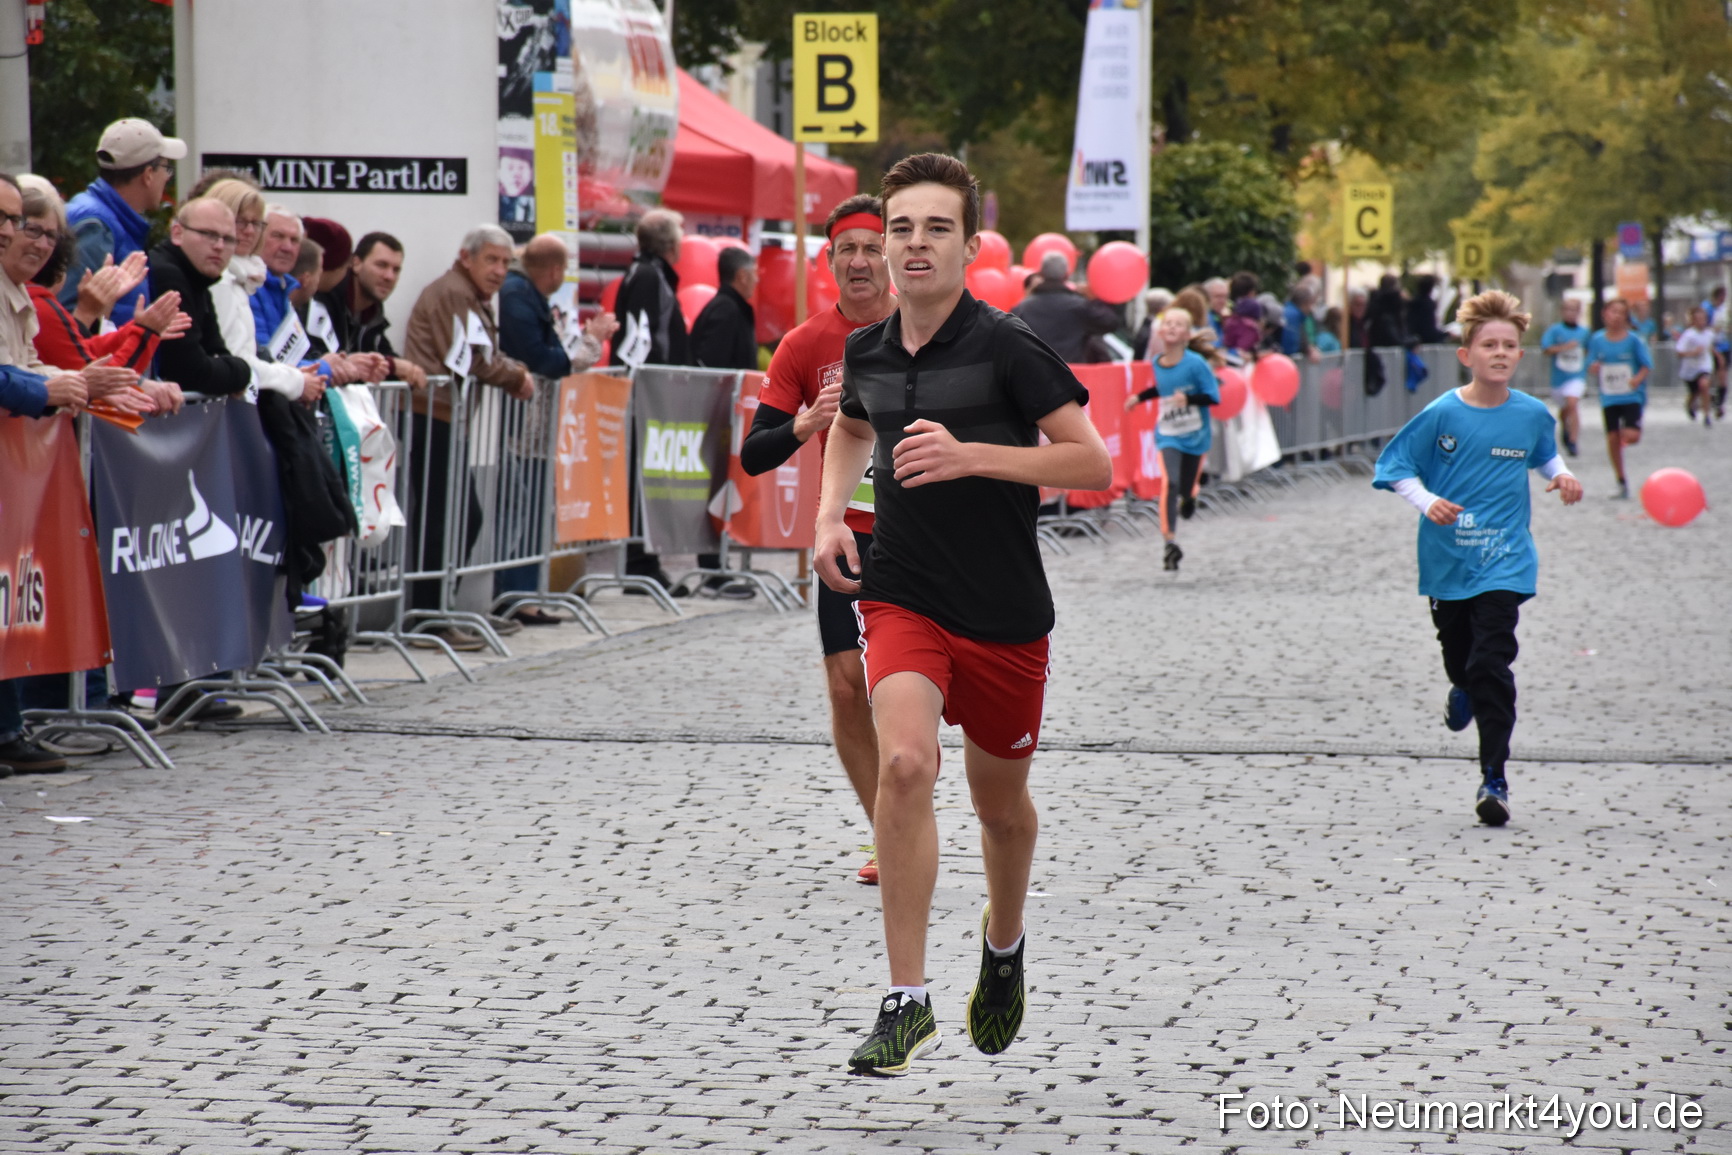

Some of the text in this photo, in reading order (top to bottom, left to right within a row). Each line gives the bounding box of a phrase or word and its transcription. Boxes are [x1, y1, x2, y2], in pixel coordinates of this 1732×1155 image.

[804, 20, 867, 42] Block
[817, 53, 856, 112] B
[538, 113, 561, 136] 18.
[258, 159, 458, 191] MINI-Partl.de
[1356, 206, 1378, 239] C
[1464, 243, 1483, 268] D
[275, 333, 298, 361] swn
[823, 367, 844, 378] IMME
[643, 427, 705, 472] BOCK
[1490, 447, 1525, 458] BOCK
[1457, 513, 1477, 528] 18.
